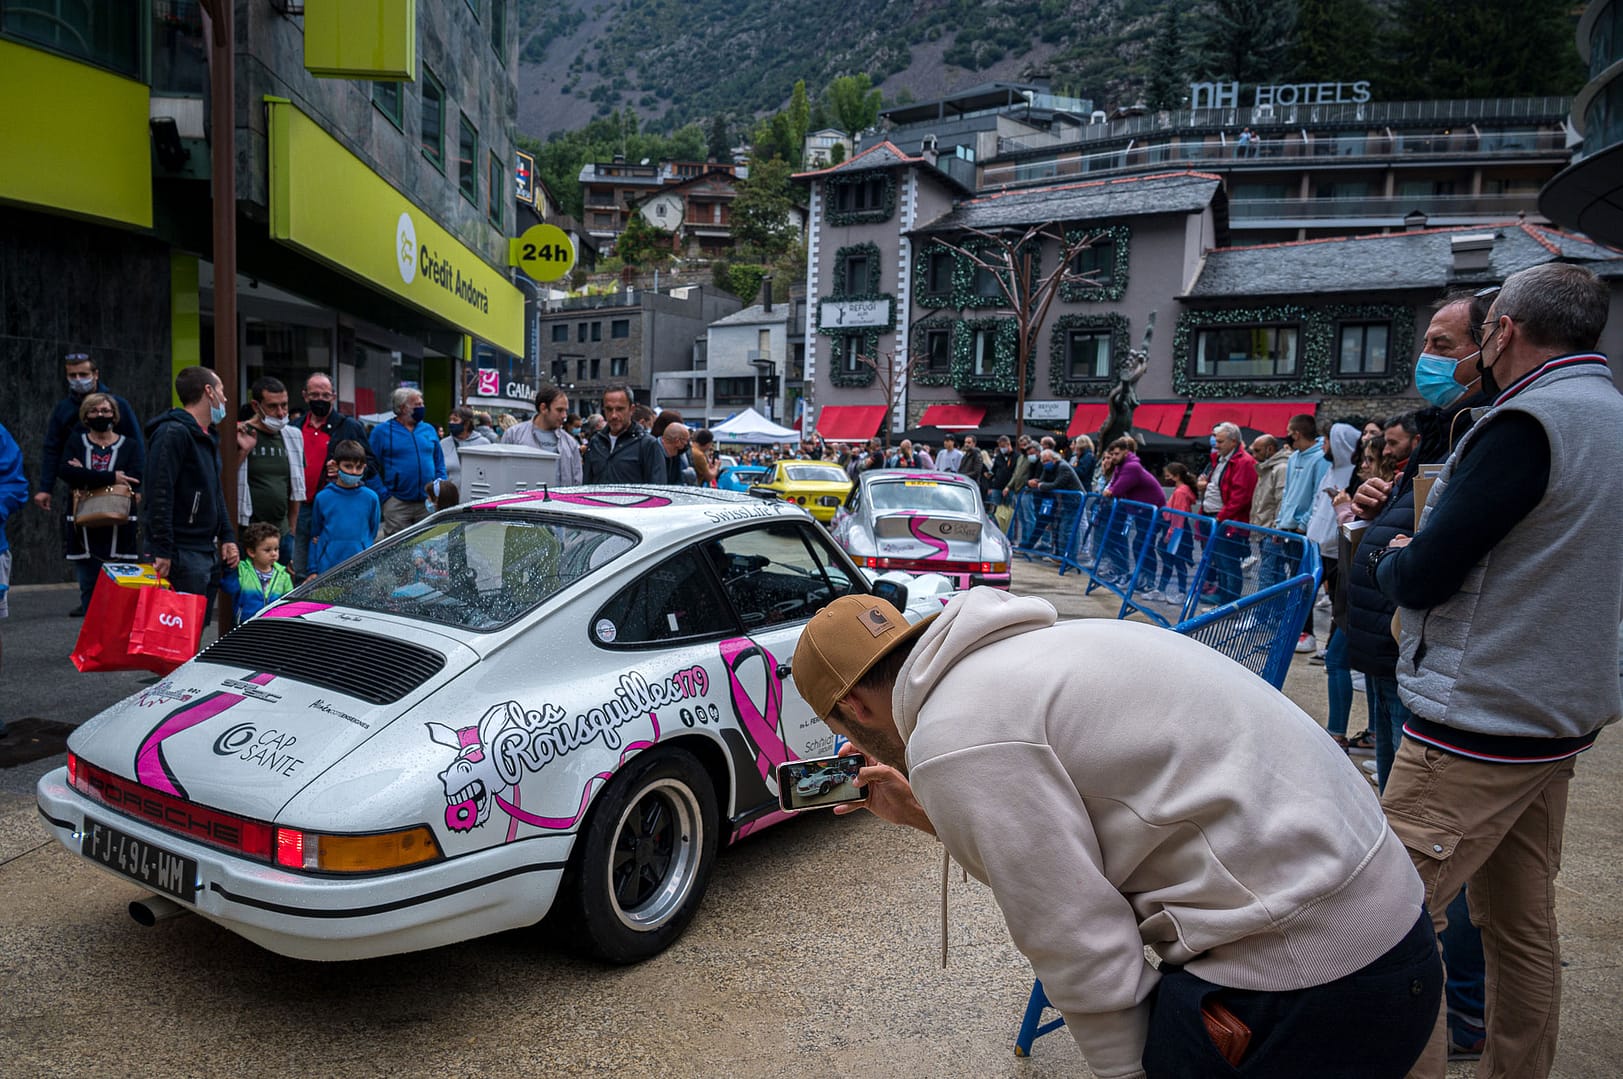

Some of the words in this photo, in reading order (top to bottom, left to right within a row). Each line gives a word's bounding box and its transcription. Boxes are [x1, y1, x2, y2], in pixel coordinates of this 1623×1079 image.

[1255, 81, 1371, 106] HOTELS
[522, 244, 568, 262] 24h
[420, 244, 453, 292] Crèdit
[455, 269, 488, 315] Andorrà
[506, 381, 531, 399] GAIA
[507, 699, 567, 733] les
[257, 729, 297, 751] CAP
[239, 744, 305, 778] SANTE
[88, 775, 240, 845] PORSCHE
[91, 823, 184, 894] FJ-494-WM
